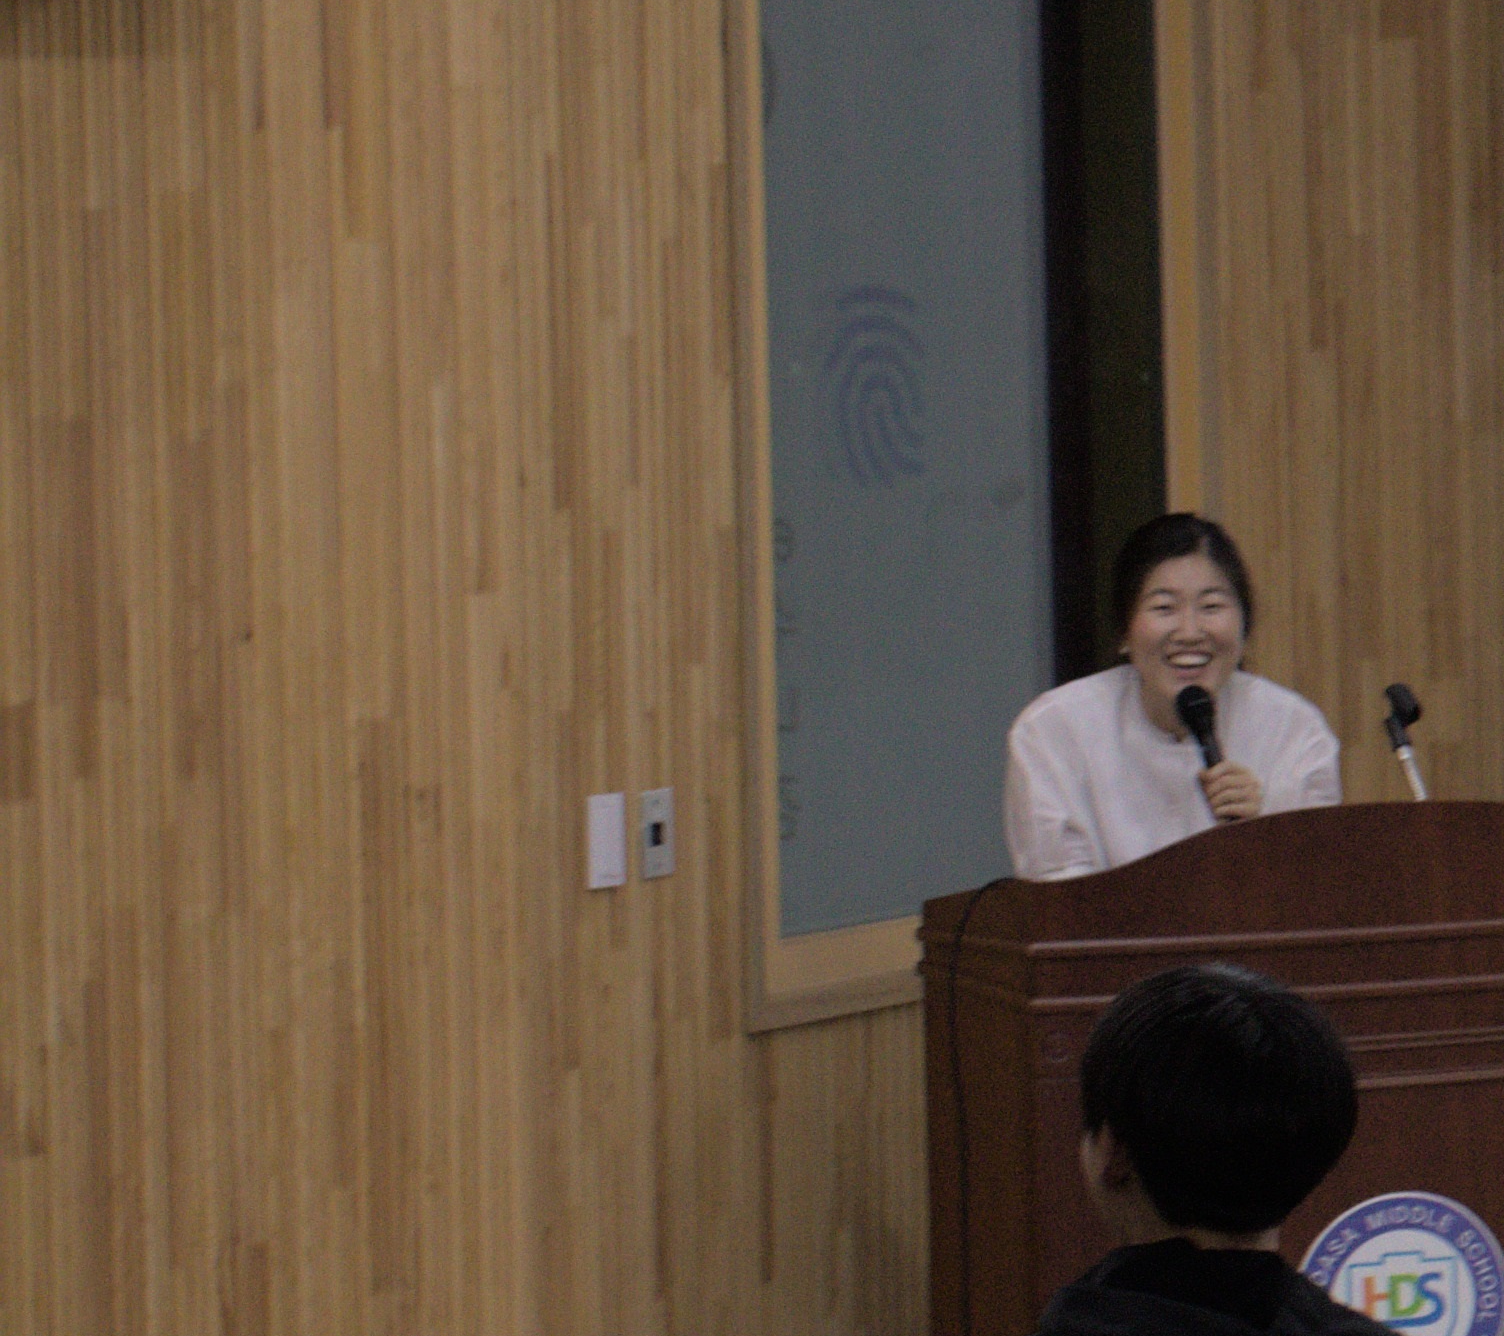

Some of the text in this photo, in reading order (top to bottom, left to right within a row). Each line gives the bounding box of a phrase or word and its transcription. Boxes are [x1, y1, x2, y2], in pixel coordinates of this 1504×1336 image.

[1308, 1227, 1361, 1287] DASA
[1457, 1228, 1500, 1320] SCHOOL
[1361, 1271, 1445, 1329] HDS
